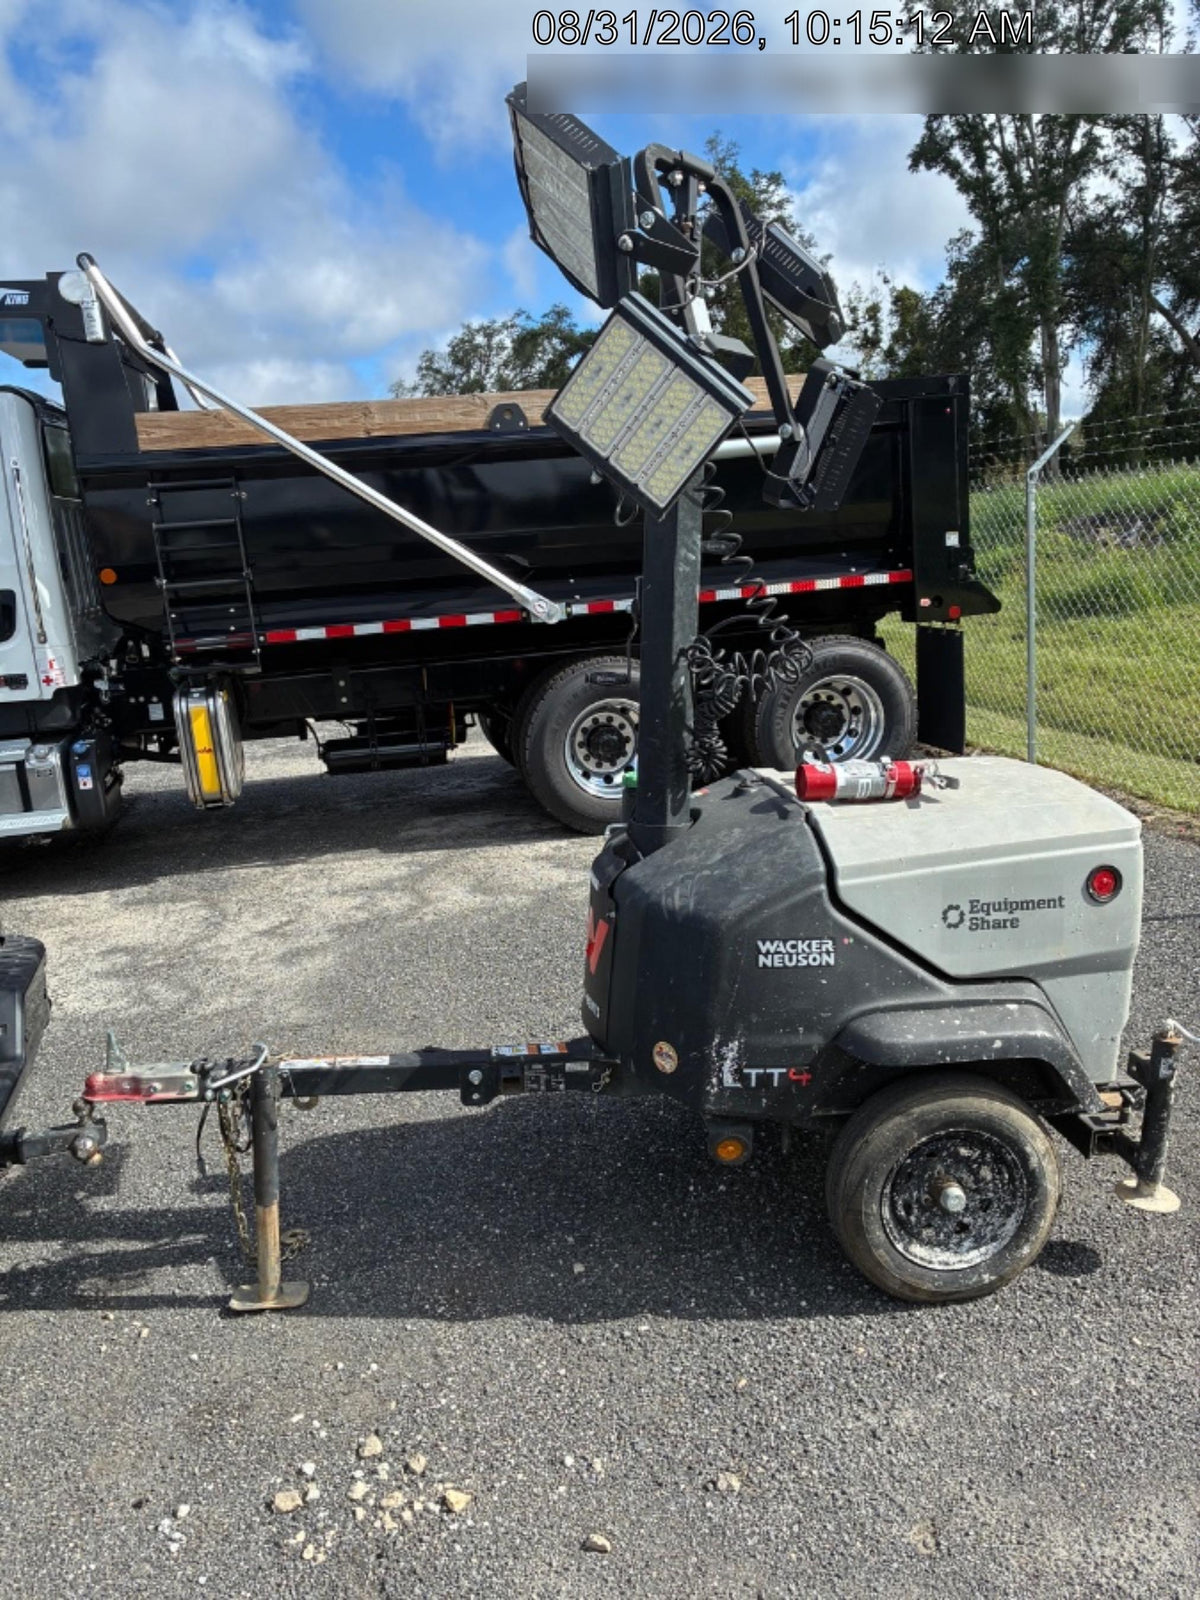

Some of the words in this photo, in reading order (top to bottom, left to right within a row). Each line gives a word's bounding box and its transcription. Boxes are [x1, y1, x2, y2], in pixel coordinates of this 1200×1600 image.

[968, 895, 1066, 916] Equipment
[968, 916, 1020, 931] Share
[756, 939, 835, 953] WACKER
[757, 953, 836, 968] NEUSON
